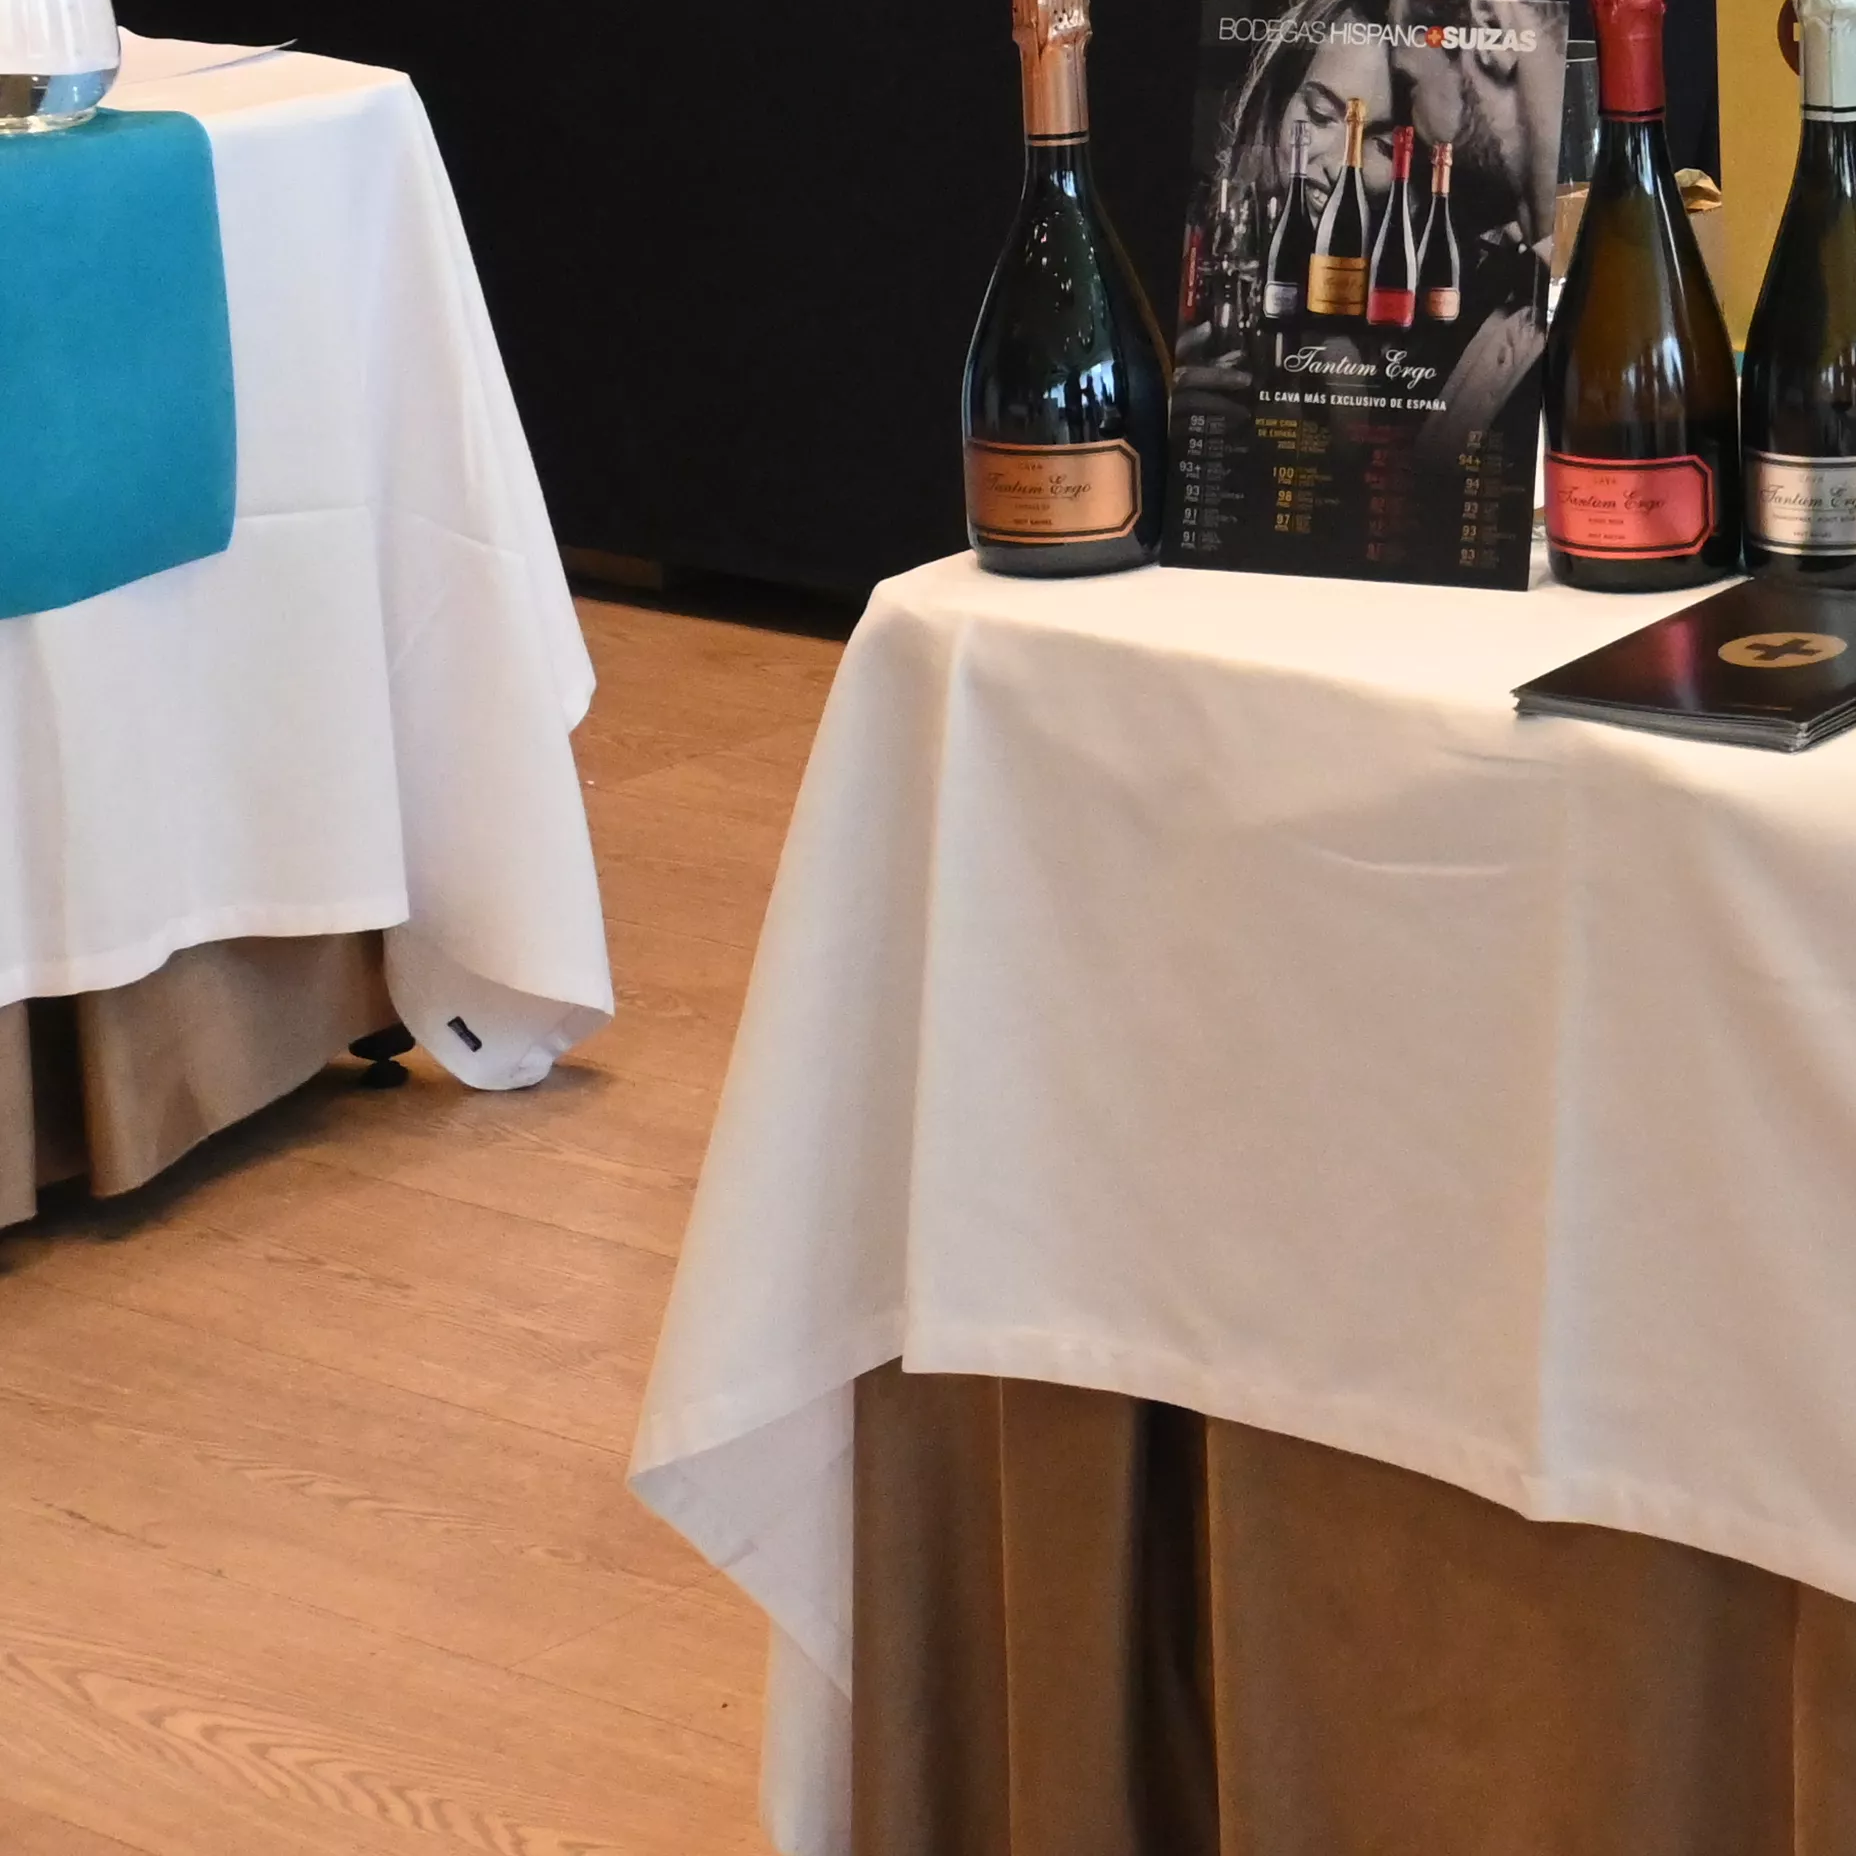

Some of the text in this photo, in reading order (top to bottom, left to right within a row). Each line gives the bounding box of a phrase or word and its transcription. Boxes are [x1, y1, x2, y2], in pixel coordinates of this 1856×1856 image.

[1218, 17, 1326, 44] BODEGAS
[1283, 345, 1438, 391] Tantum Ergo
[1259, 391, 1447, 411] EL CAVA MÁS EXCLUSIVO DE ESPAÑA
[985, 472, 1091, 501] Tantum Ergo
[1760, 484, 1823, 508] Tantum
[1558, 485, 1666, 518] Tantum Ergo
